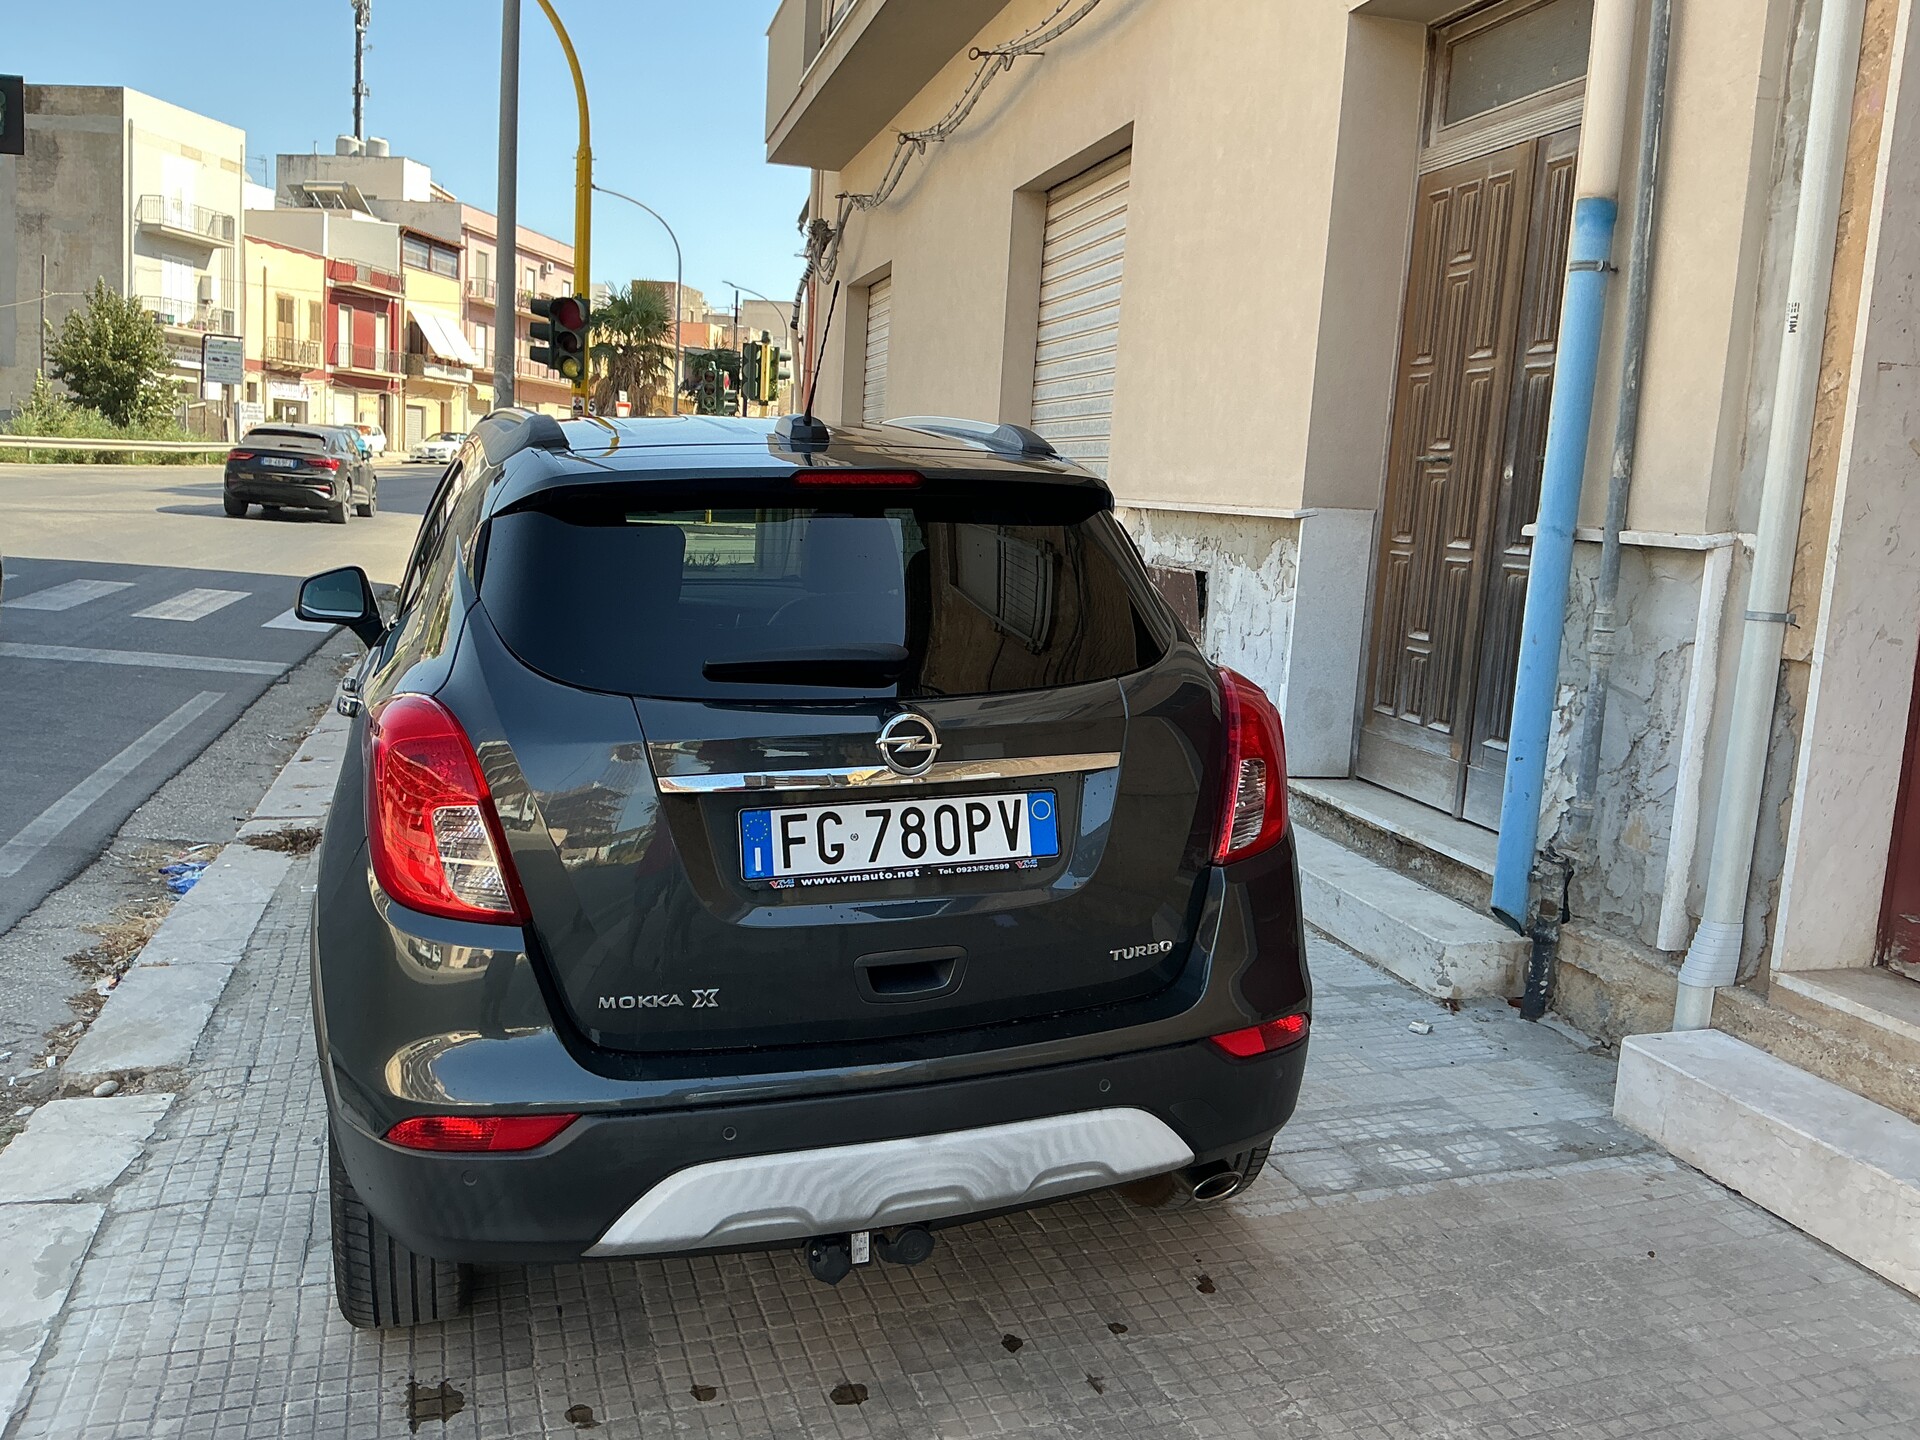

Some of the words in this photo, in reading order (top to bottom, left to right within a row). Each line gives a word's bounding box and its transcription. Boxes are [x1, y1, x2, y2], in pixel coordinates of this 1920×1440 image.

[780, 811, 845, 869] FG
[865, 799, 1022, 863] 780PV
[801, 868, 920, 886] www.vmauto.net
[938, 867, 954, 875] Tel.
[1109, 940, 1173, 961] TURBO
[598, 994, 684, 1009] MOKKA
[691, 988, 720, 1008] X
